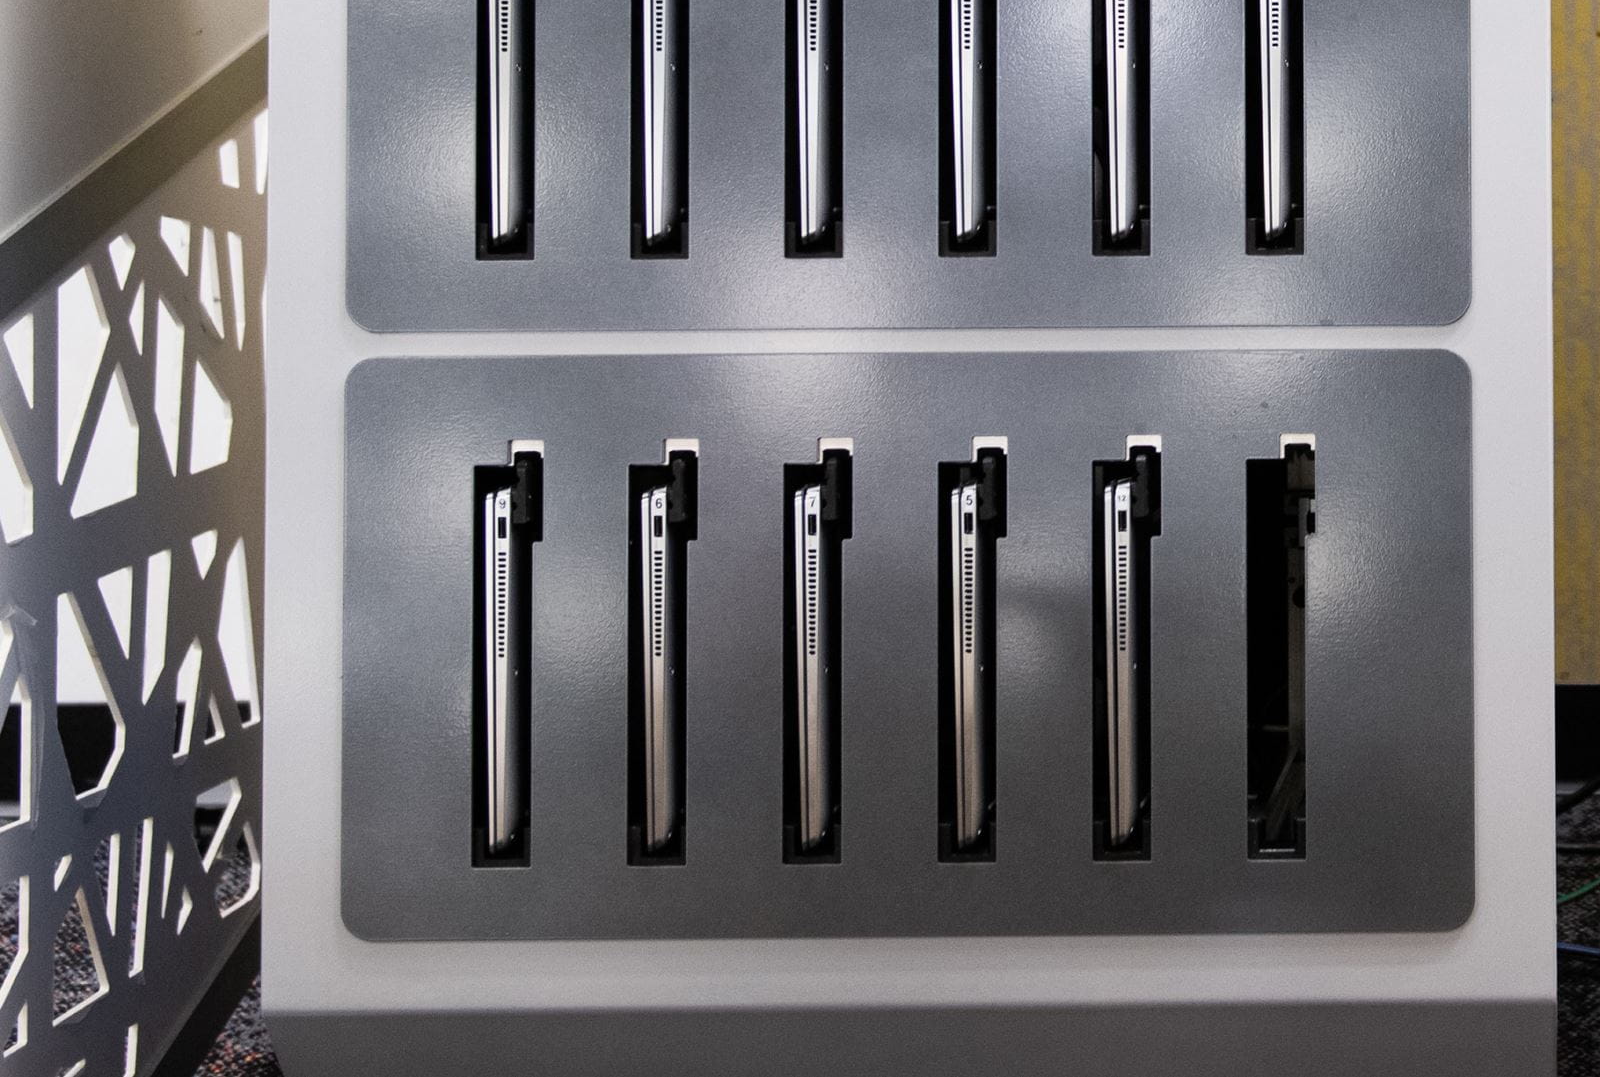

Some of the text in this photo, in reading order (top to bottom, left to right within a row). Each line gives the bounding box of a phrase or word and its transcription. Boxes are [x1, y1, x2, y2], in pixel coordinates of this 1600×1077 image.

[498, 498, 507, 510] 9
[655, 497, 663, 510] 6
[809, 496, 816, 508] 7
[965, 494, 974, 506] 5
[1117, 494, 1127, 503] 12
